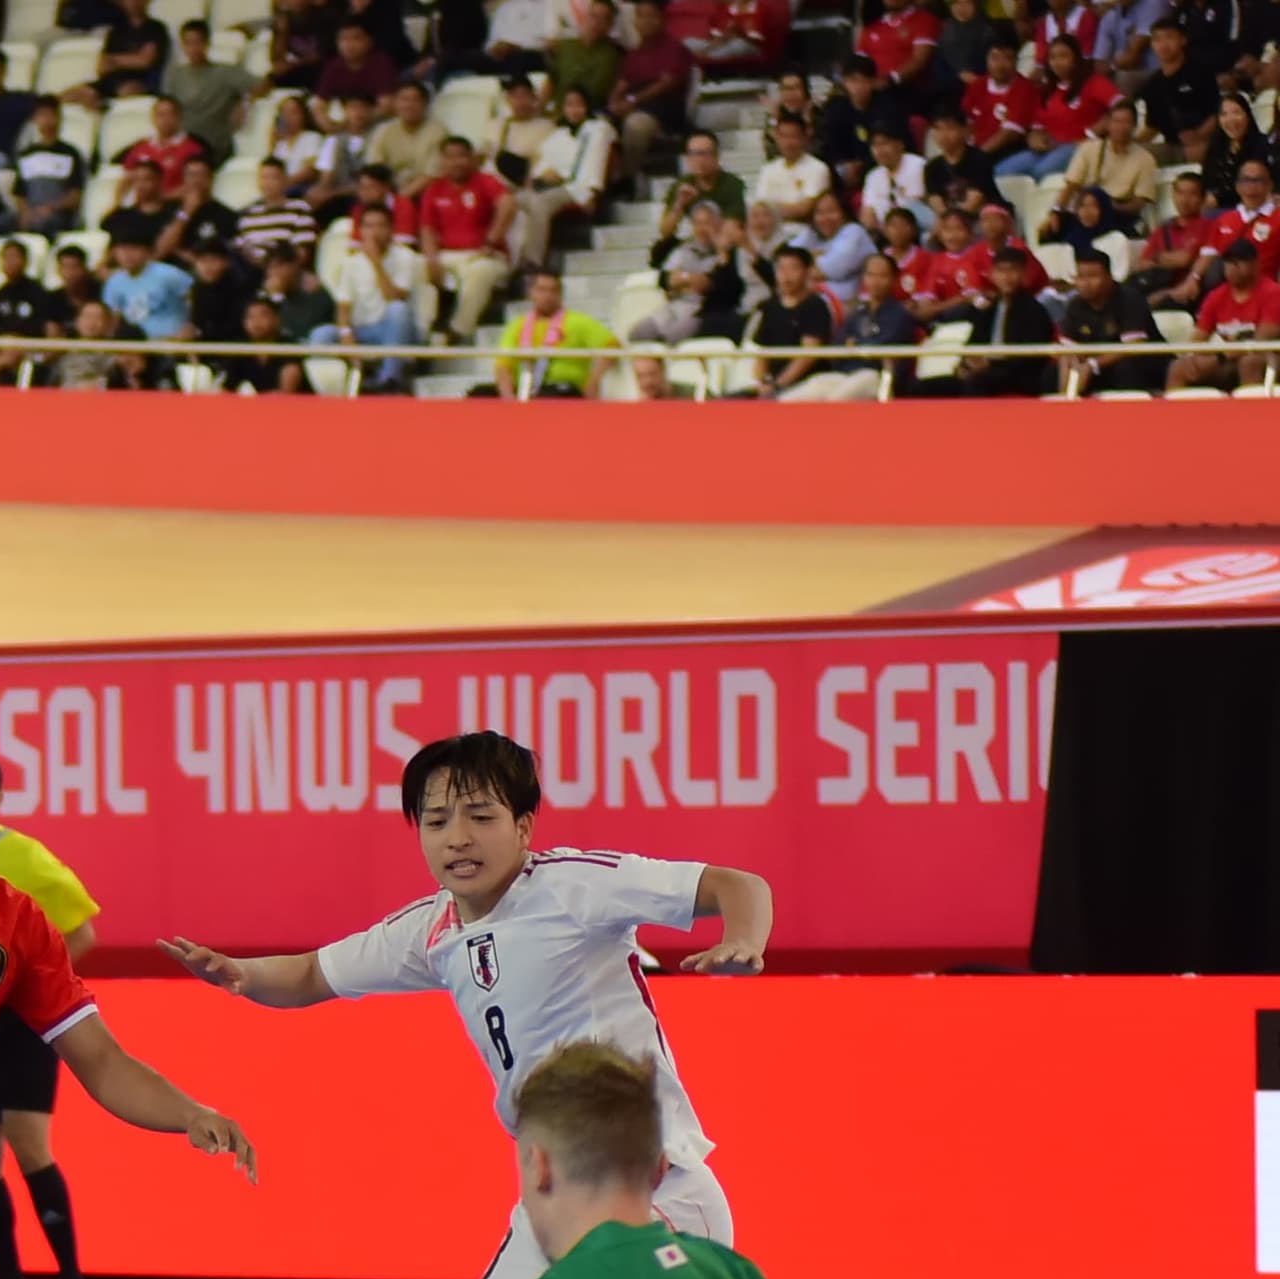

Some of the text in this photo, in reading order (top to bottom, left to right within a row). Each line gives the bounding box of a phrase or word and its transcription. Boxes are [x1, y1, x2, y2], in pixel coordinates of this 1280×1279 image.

[176, 677, 422, 815] 4NWS
[815, 659, 1058, 804] SERI
[485, 1005, 514, 1071] 8
